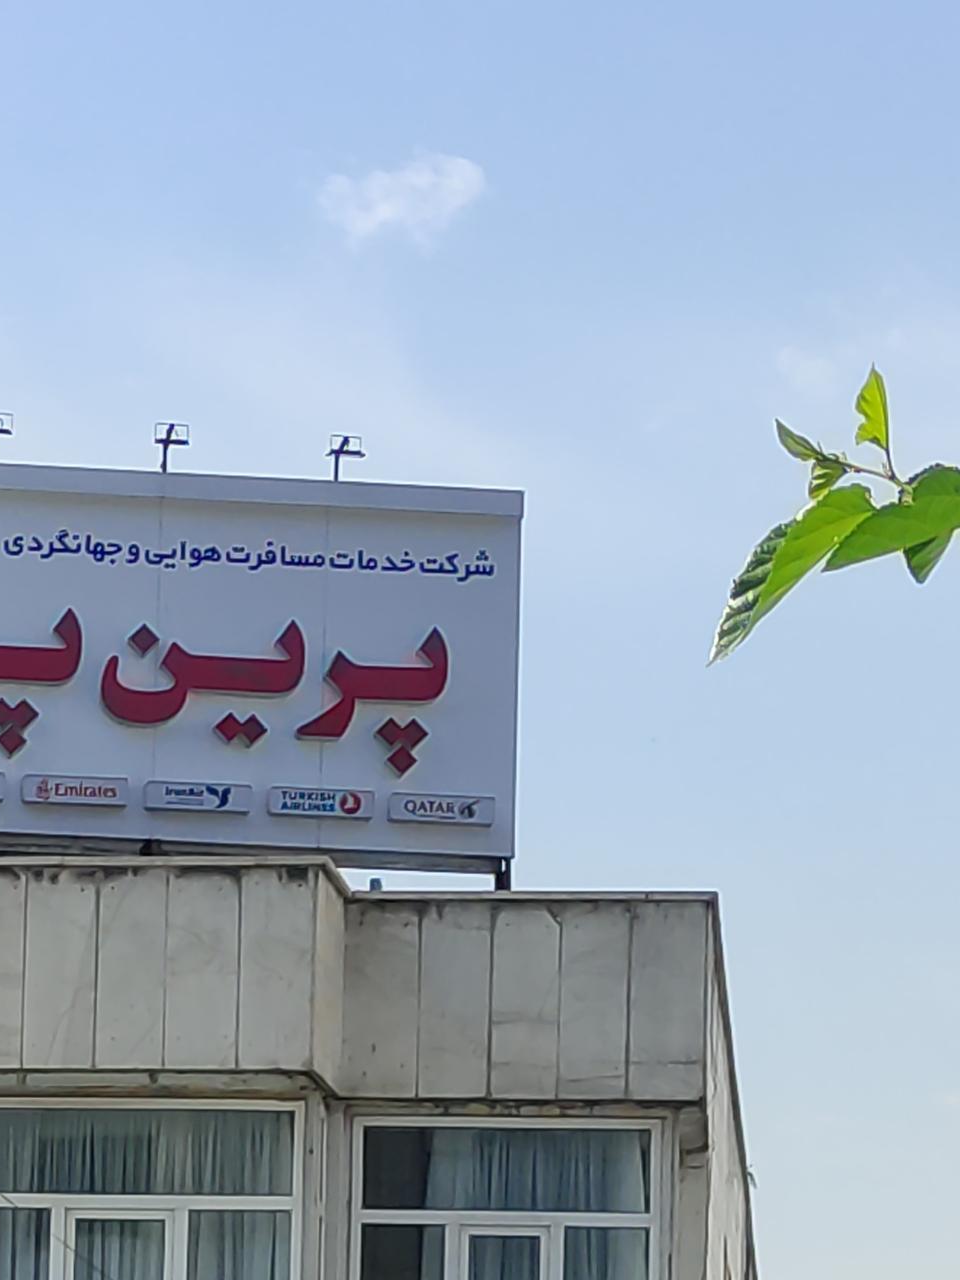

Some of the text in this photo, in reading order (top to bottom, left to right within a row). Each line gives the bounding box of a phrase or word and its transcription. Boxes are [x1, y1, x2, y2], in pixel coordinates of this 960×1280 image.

[3, 528, 495, 582] شرکت خدمات مسافرت هوایی و جهانگردی
[99, 618, 450, 779] پرین
[53, 780, 118, 798] Emirates
[281, 790, 336, 802] TURKISH
[280, 800, 336, 812] AIRLINES
[404, 799, 455, 815] QATAR
